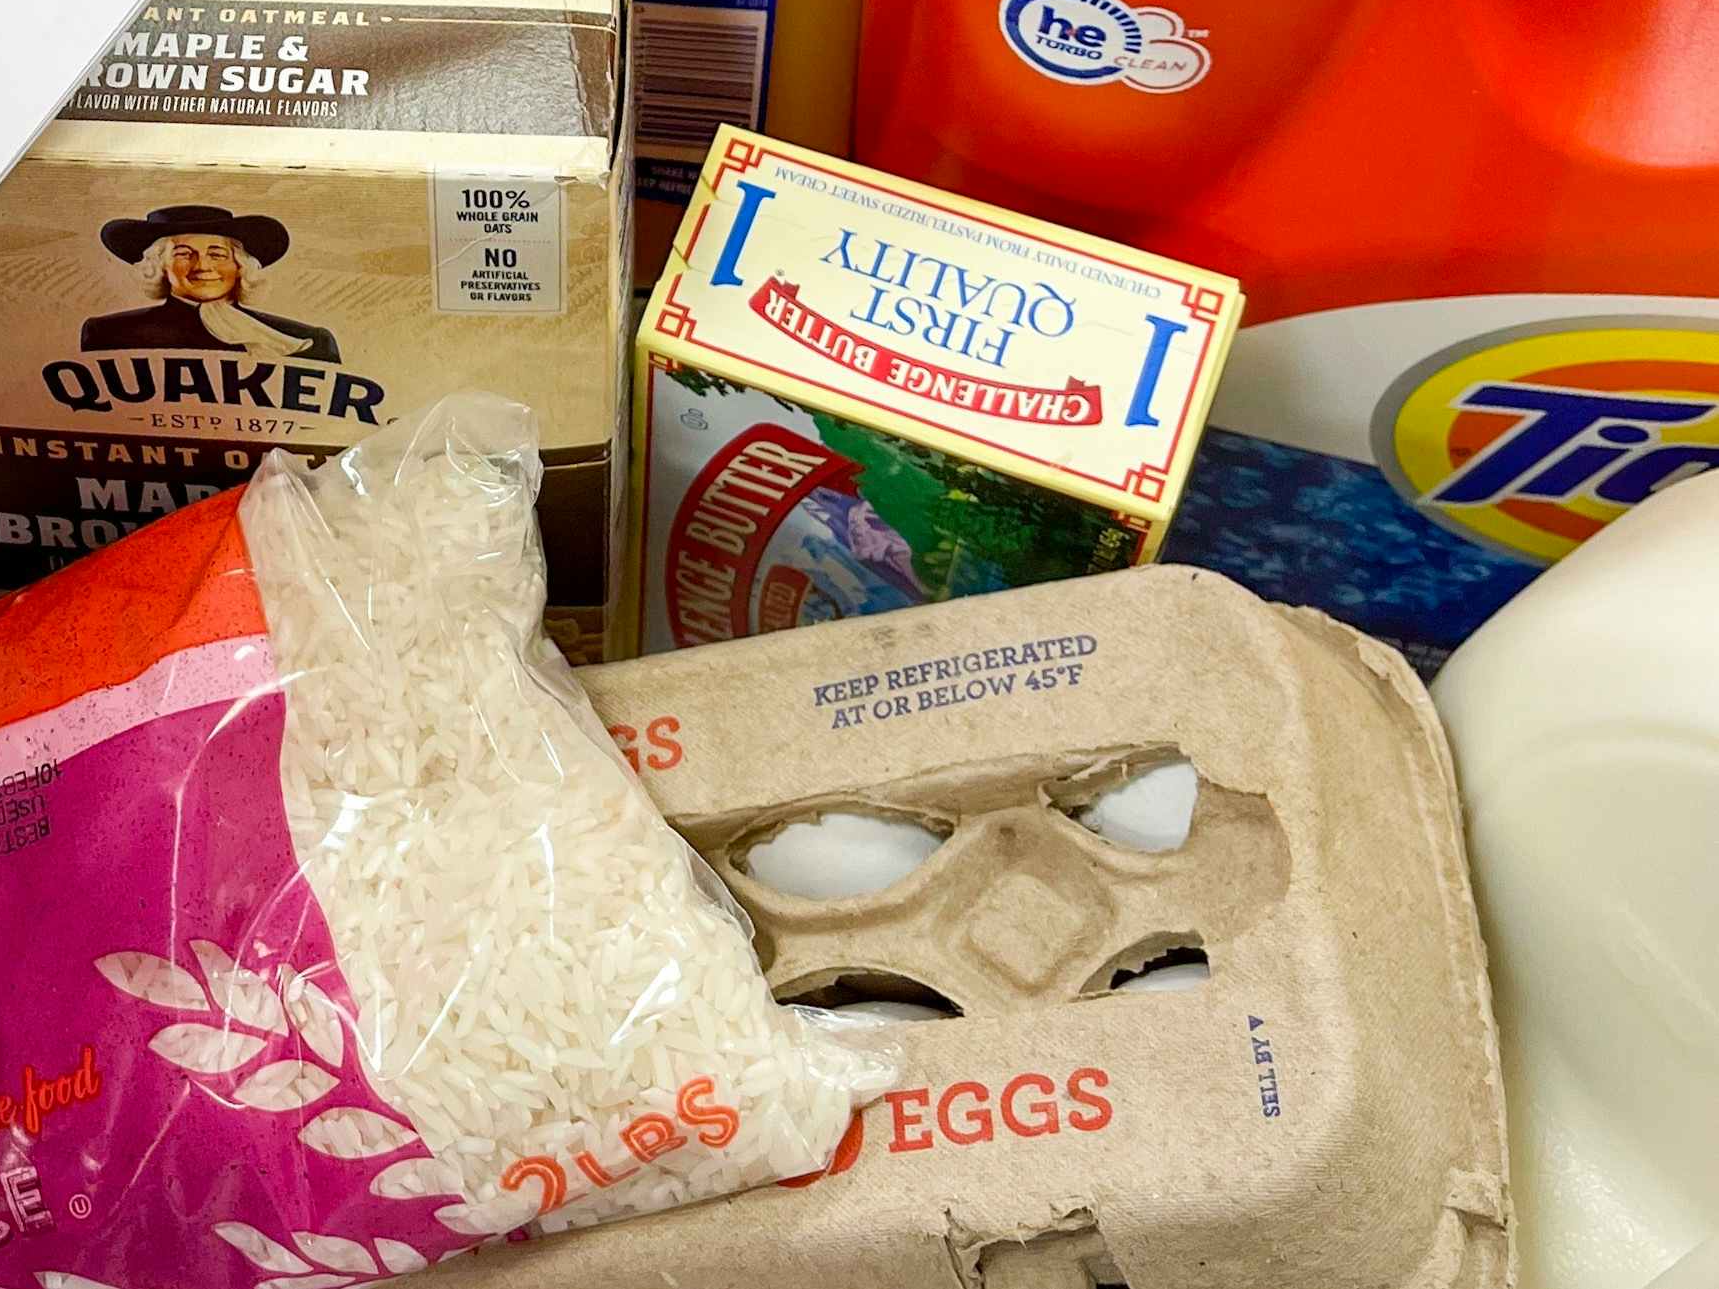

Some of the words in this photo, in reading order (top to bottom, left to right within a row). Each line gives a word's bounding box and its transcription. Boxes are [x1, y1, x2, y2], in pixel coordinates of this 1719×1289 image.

[143, 7, 206, 23] ANT
[219, 8, 371, 27] OATMEAL
[1038, 5, 1108, 49] he
[114, 31, 266, 62] MAPLE
[278, 34, 309, 62] &
[1035, 34, 1103, 61] TURBO
[1113, 55, 1188, 73] CLEAN
[219, 65, 370, 97] SUGAR
[124, 94, 159, 112] WITH
[162, 96, 206, 113] OTHER
[210, 97, 272, 116] NATURAL
[276, 98, 338, 118] FLAVORS
[775, 165, 828, 194] CREAM
[461, 189, 531, 210] 100%
[828, 184, 882, 211] SWEET
[456, 211, 498, 222] WHOLE
[501, 211, 539, 223] GRAIN
[483, 223, 513, 234] OATS
[882, 203, 983, 243] PASTEURIZED
[709, 179, 777, 289] 1
[985, 233, 1031, 262] FROM
[484, 247, 518, 268] NO
[1034, 251, 1078, 274] DAILY
[460, 280, 541, 291] PRESERVATIVES
[471, 270, 530, 281] ARTIFICIAL
[818, 226, 1078, 338] QUALITY
[1081, 266, 1162, 299] CHURNED
[470, 292, 484, 301] OR
[487, 292, 532, 302] FLAVORS
[764, 287, 877, 371] BUTTER
[850, 284, 1016, 369] FIRST
[1125, 313, 1189, 429] 1
[41, 357, 386, 426] QUAKER
[890, 358, 1091, 424] CHALLENGE
[236, 417, 295, 435] 1877
[686, 440, 828, 557] BUTTER
[813, 673, 880, 708] KEEP
[885, 634, 1098, 692] REFRIGERATED
[831, 703, 867, 730] AT
[872, 695, 912, 721] OR
[917, 673, 1017, 713] BELOW
[1022, 664, 1084, 692] 45°F
[1251, 1033, 1273, 1065] BY
[24, 1046, 100, 1134] food
[1255, 1066, 1281, 1119] SELL
[885, 1067, 1114, 1155] EGGS
